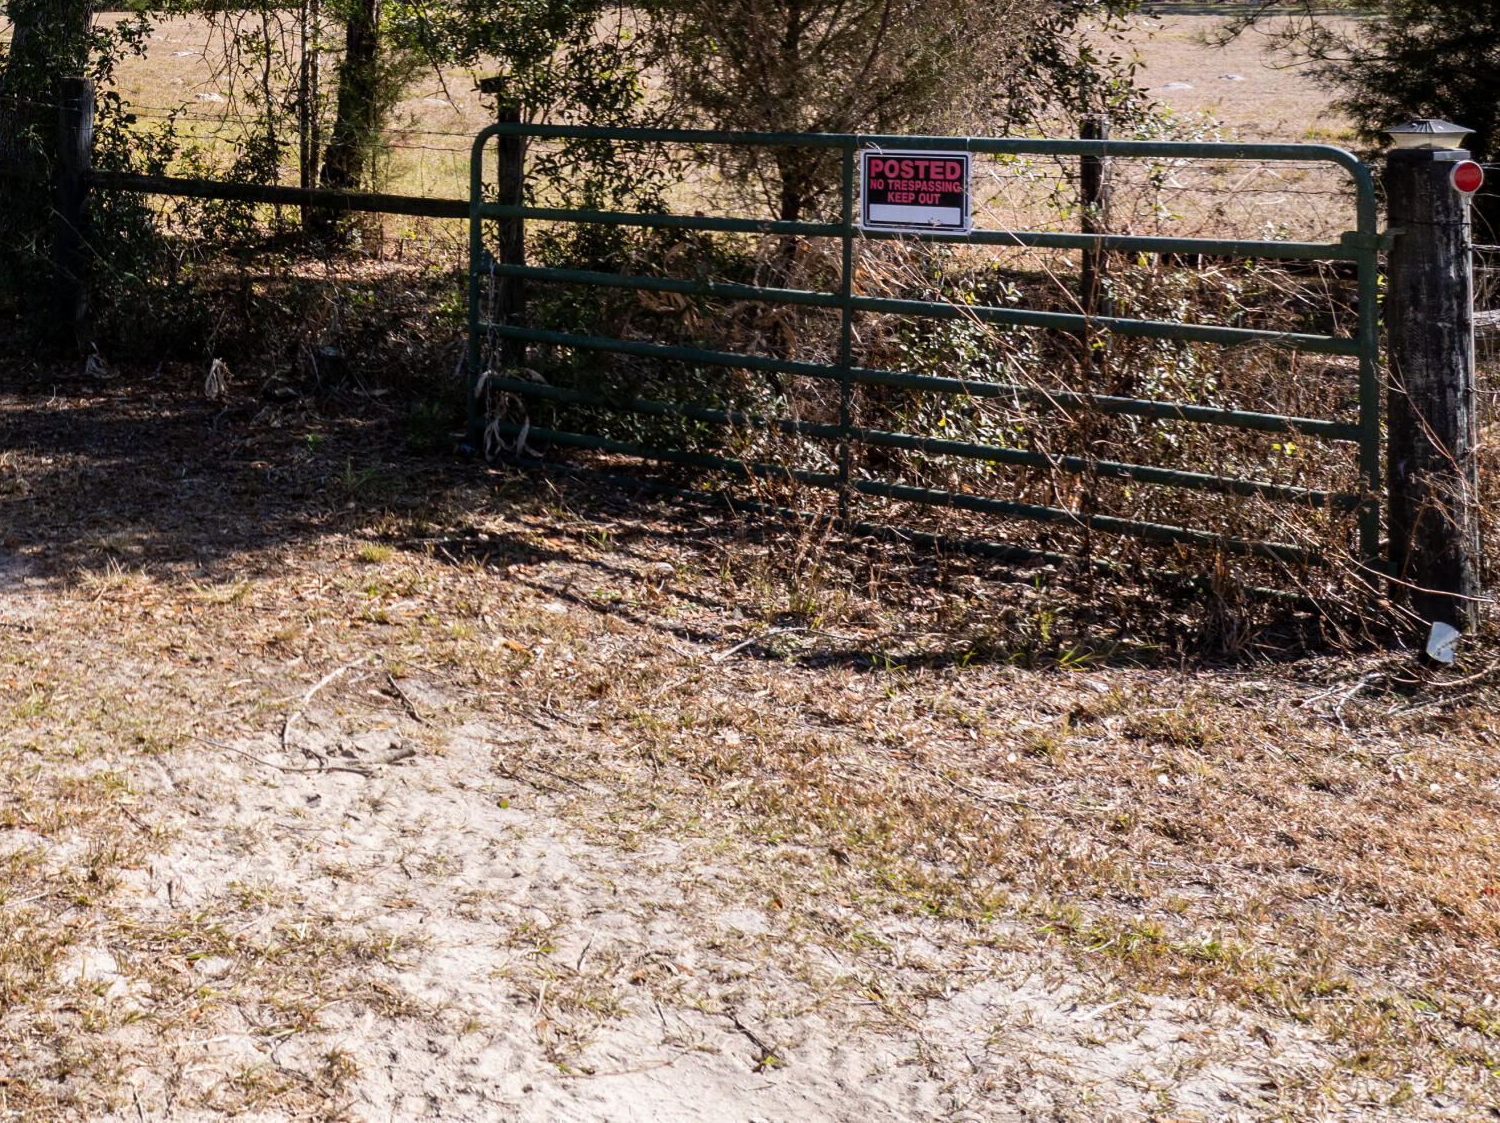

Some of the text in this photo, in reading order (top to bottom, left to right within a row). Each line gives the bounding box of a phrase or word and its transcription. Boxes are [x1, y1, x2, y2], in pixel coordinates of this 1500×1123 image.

[870, 159, 961, 180] POSTED
[870, 179, 961, 193] NO TRESPASSING
[887, 192, 940, 204] KEEP OUT
